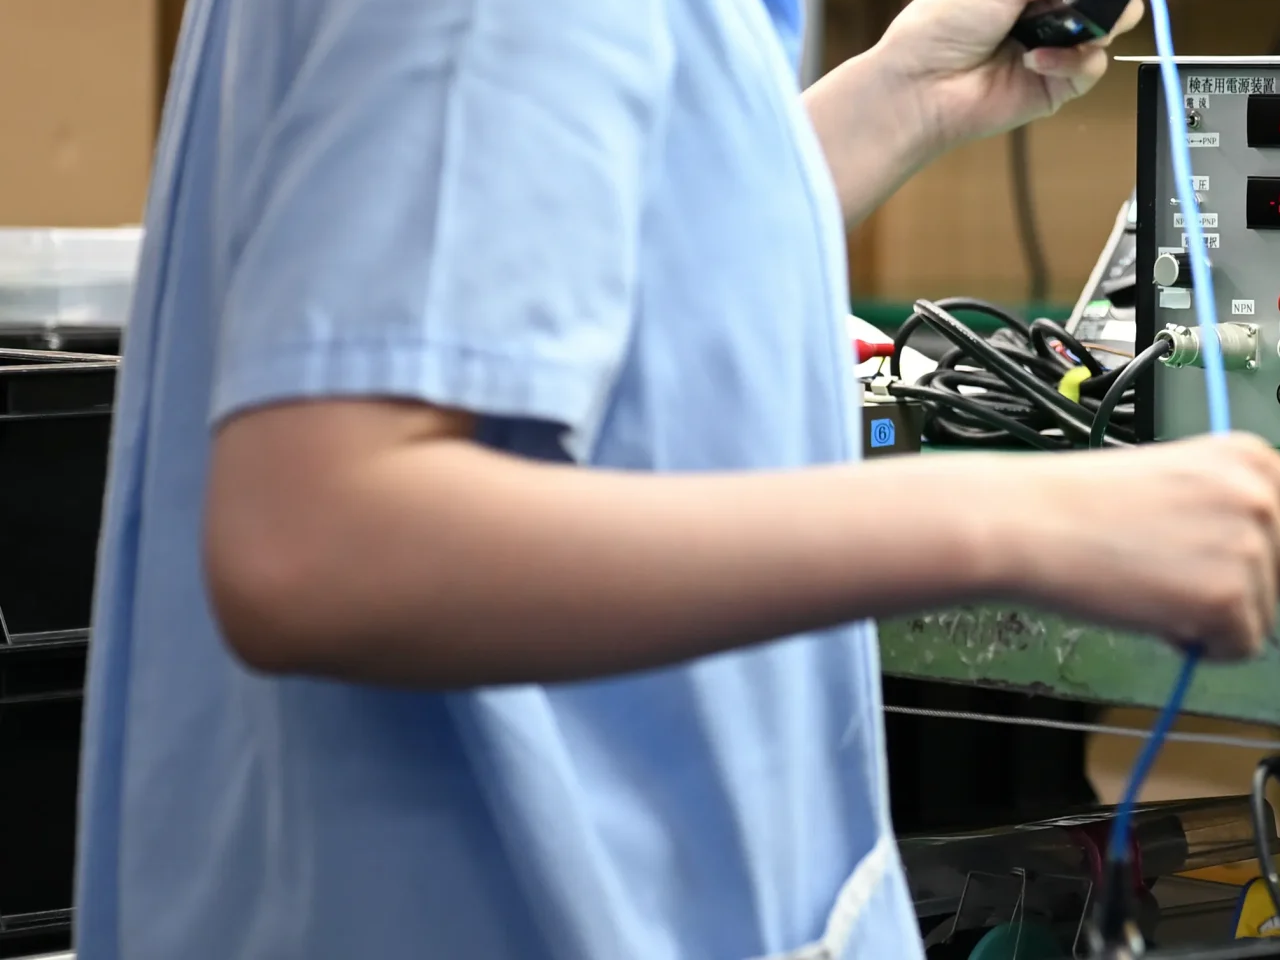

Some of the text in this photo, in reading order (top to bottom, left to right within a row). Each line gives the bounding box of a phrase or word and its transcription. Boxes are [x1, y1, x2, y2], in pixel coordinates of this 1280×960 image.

[1188, 77, 1275, 93] 検査用電源装置
[1234, 303, 1253, 313] NPN
